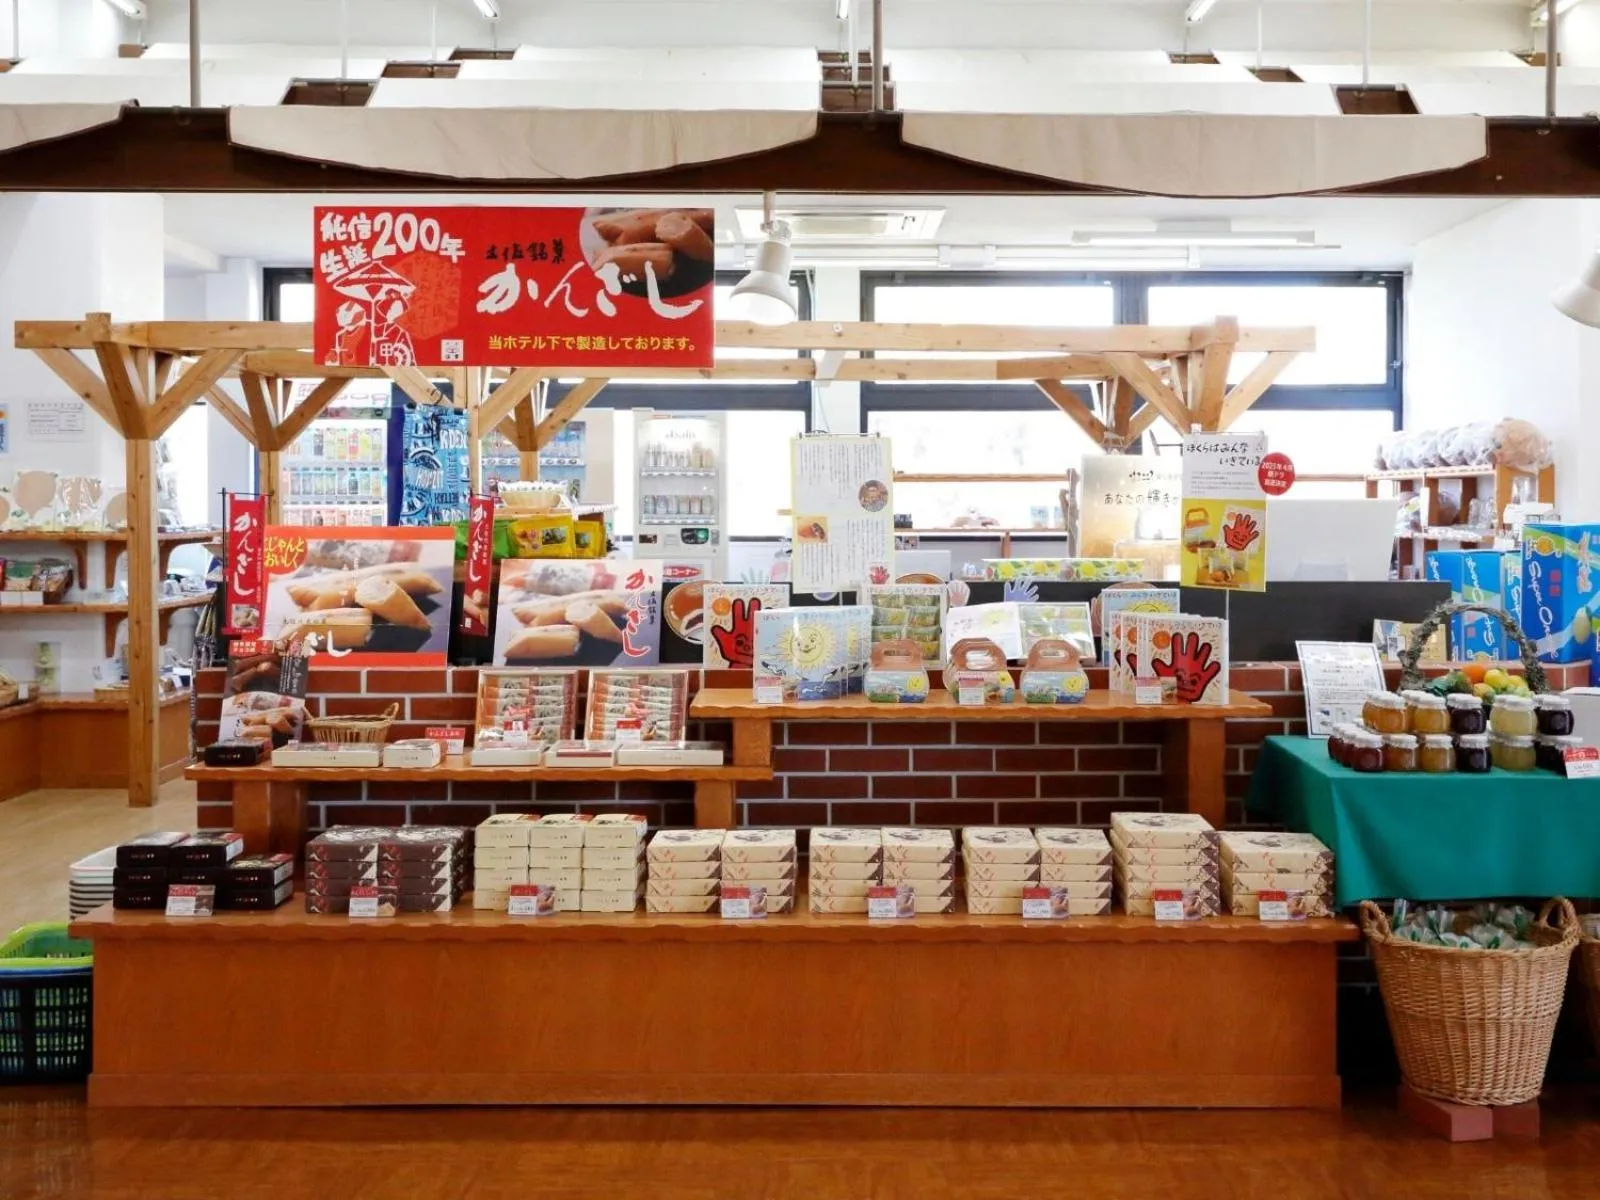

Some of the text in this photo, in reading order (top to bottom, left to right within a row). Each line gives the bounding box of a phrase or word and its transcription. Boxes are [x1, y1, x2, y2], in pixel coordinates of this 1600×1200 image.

[372, 212, 466, 263] 200年
[476, 262, 704, 319] かんざし
[489, 335, 696, 351] 当ホテル下で製造しております。
[233, 512, 258, 596] かんざし
[469, 504, 487, 582] かんざし
